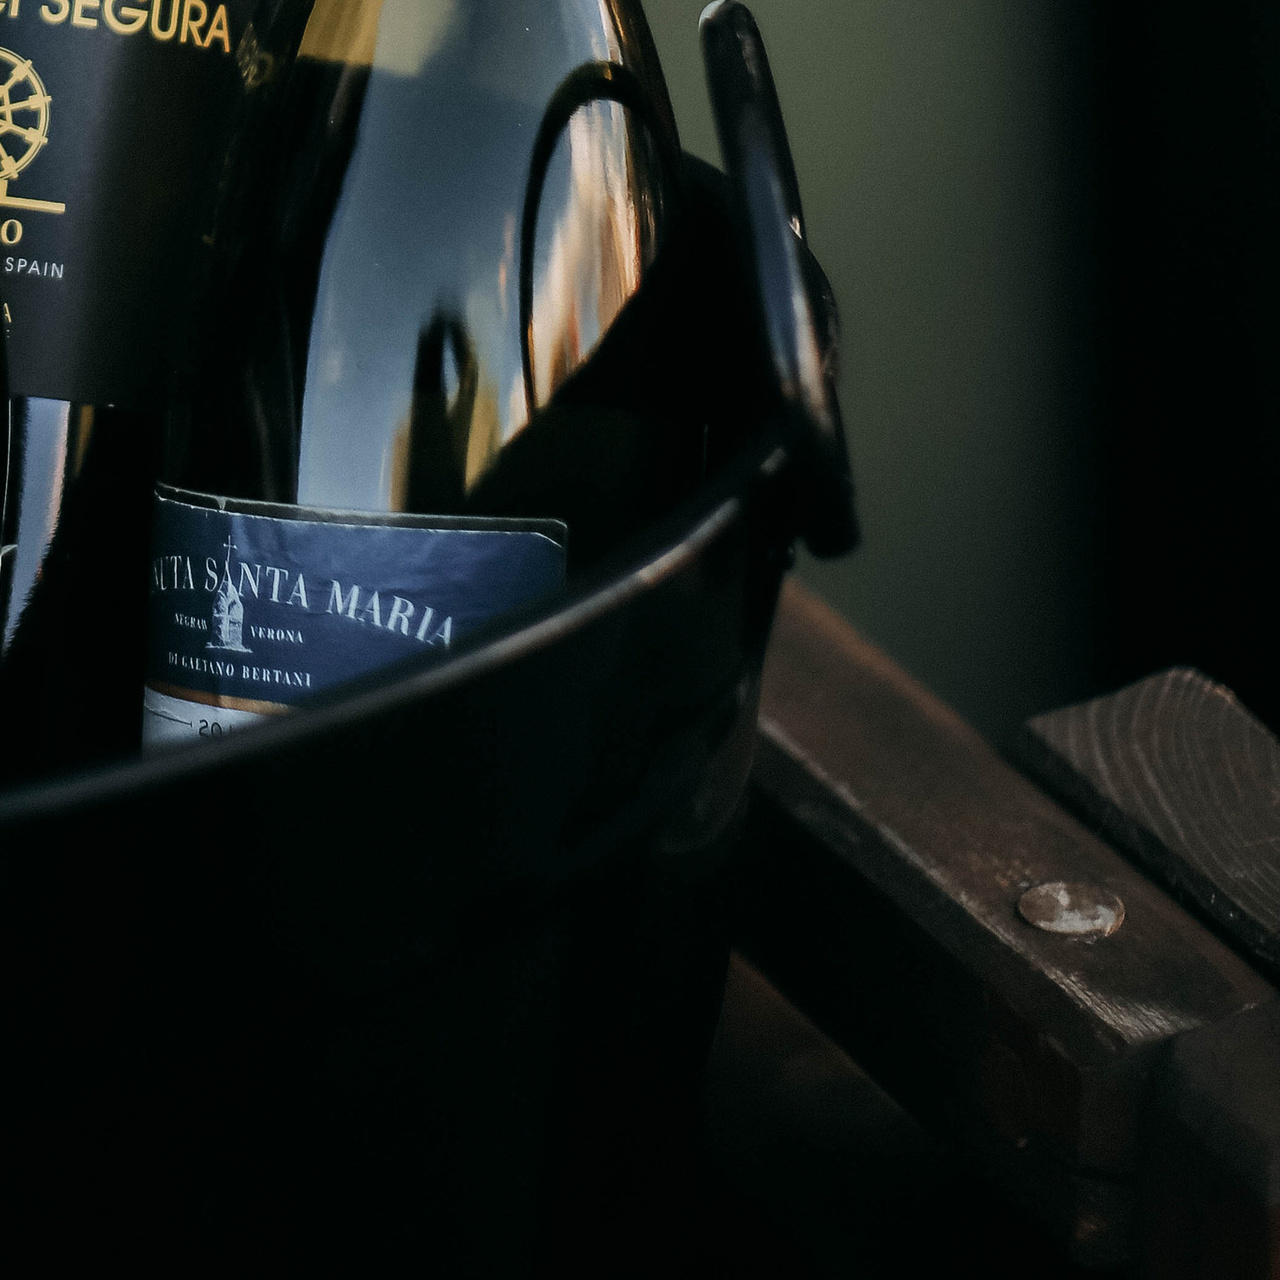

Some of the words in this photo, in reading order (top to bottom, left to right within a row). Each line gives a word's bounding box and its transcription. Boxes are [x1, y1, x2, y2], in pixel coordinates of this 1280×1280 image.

[5, 256, 64, 279] SPAIN
[204, 556, 309, 609] SANTA
[326, 578, 454, 647] MARIA
[250, 625, 304, 644] VERONA
[181, 654, 235, 678] GAETANO
[241, 664, 312, 689] BERTANI
